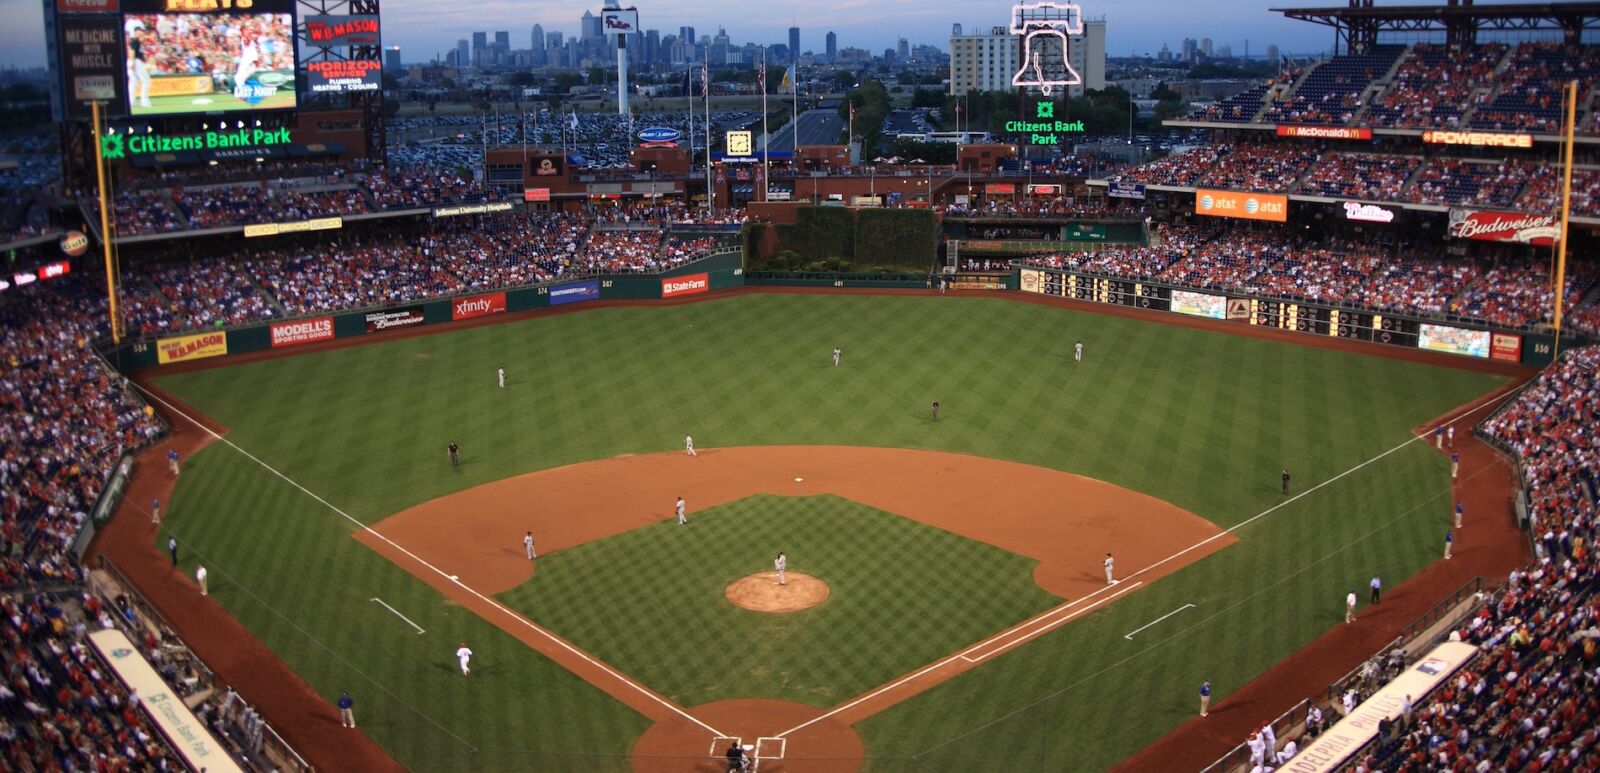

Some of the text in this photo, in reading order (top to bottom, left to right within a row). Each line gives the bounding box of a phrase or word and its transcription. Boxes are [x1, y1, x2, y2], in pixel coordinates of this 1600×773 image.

[65, 29, 116, 43] MEDICINE
[72, 54, 113, 68] MUSCLE
[308, 60, 380, 72] HORIZON
[323, 69, 367, 78] SERVICES
[254, 85, 278, 97] NIGHT
[313, 83, 378, 92] HEATING COOLING
[1005, 120, 1085, 132] Citizens Bank
[1296, 126, 1351, 138] McDonald's
[128, 126, 293, 154] Citizens Bank Park
[1031, 133, 1058, 145] Park
[1432, 131, 1533, 148] POWERADE
[435, 202, 512, 218] Jefferson University Hospitals
[1215, 198, 1237, 210] at&t
[1260, 202, 1283, 214] at&t
[1343, 200, 1394, 222] Phillies
[1453, 214, 1554, 238] Budweiser
[64, 237, 87, 250] Gulf
[456, 298, 491, 315] xfinity
[273, 320, 332, 338] MODELL'S
[373, 315, 425, 329] Budweiser
[274, 330, 332, 344] SPORTING GOODS
[1348, 694, 1403, 730] PHILLIES
[158, 702, 210, 758] Citizens Bank Park
